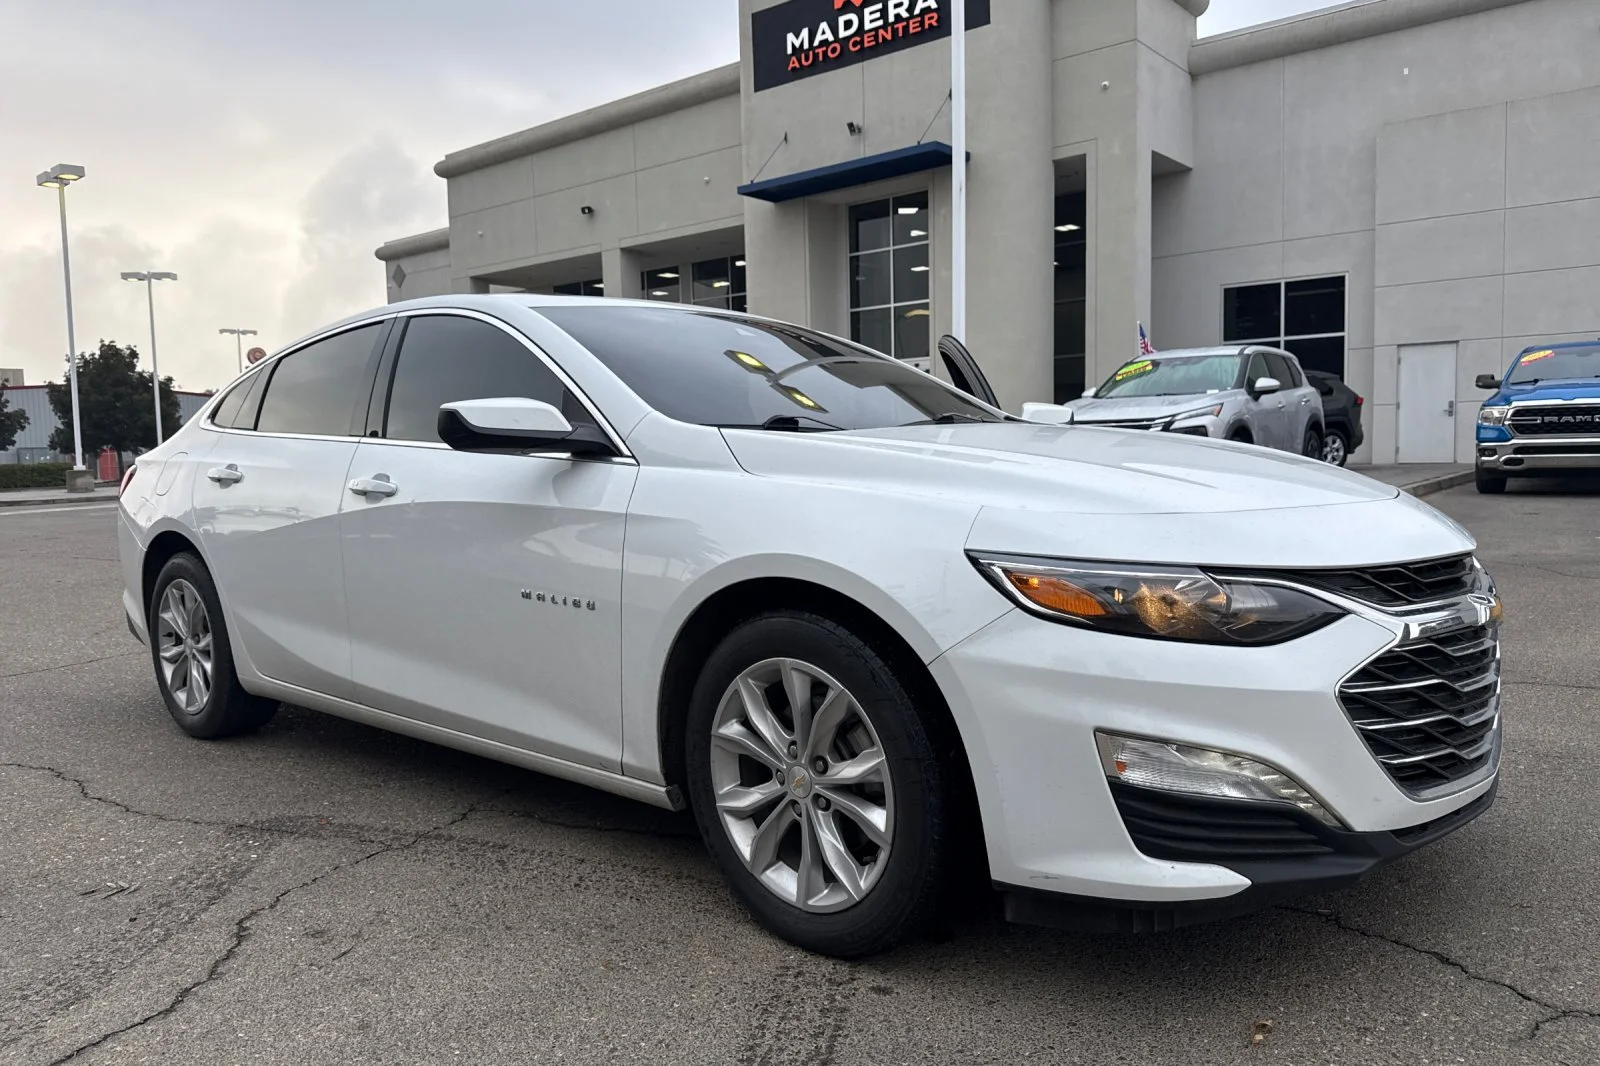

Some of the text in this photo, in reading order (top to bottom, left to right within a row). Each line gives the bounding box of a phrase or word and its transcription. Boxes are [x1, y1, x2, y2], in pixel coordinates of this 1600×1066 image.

[786, 0, 939, 55] MADERA
[787, 12, 939, 71] AUTO CENTER
[1543, 415, 1593, 423] RAM
[520, 588, 596, 611] MALIBU
